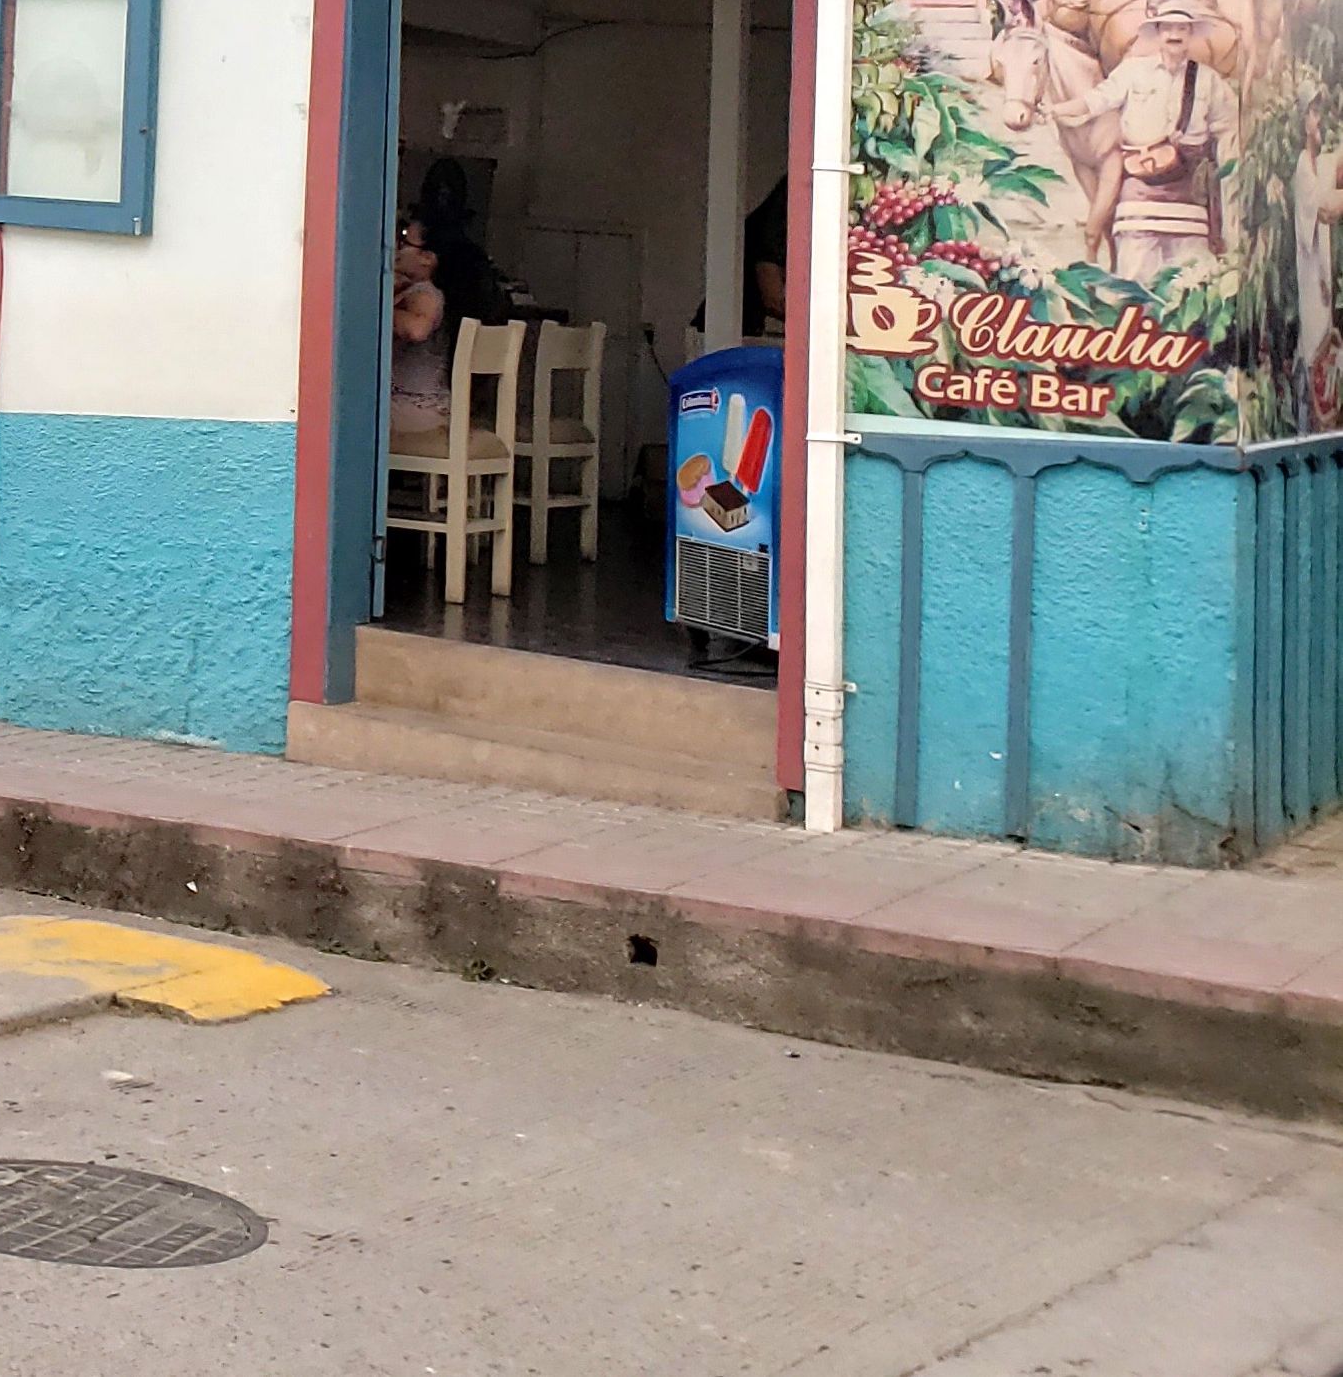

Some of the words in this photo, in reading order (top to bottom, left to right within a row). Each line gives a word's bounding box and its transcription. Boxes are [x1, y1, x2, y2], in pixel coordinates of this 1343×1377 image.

[952, 293, 1204, 369] Claudia
[917, 366, 1017, 405] Café
[1031, 375, 1111, 413] Bar
